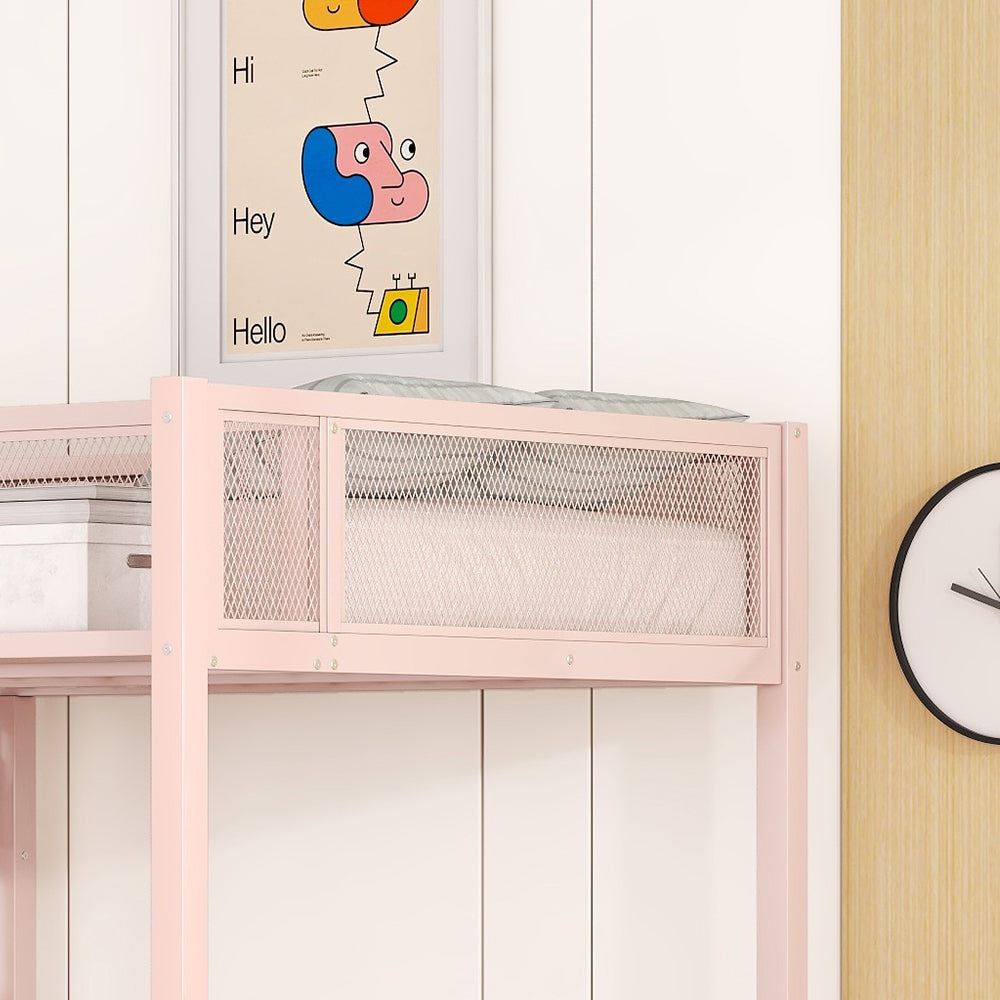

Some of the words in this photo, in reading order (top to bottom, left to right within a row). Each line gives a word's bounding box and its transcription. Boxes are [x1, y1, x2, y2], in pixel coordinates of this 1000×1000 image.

[233, 56, 254, 84] Hi
[233, 207, 275, 239] Hey
[233, 317, 286, 345] Hello
